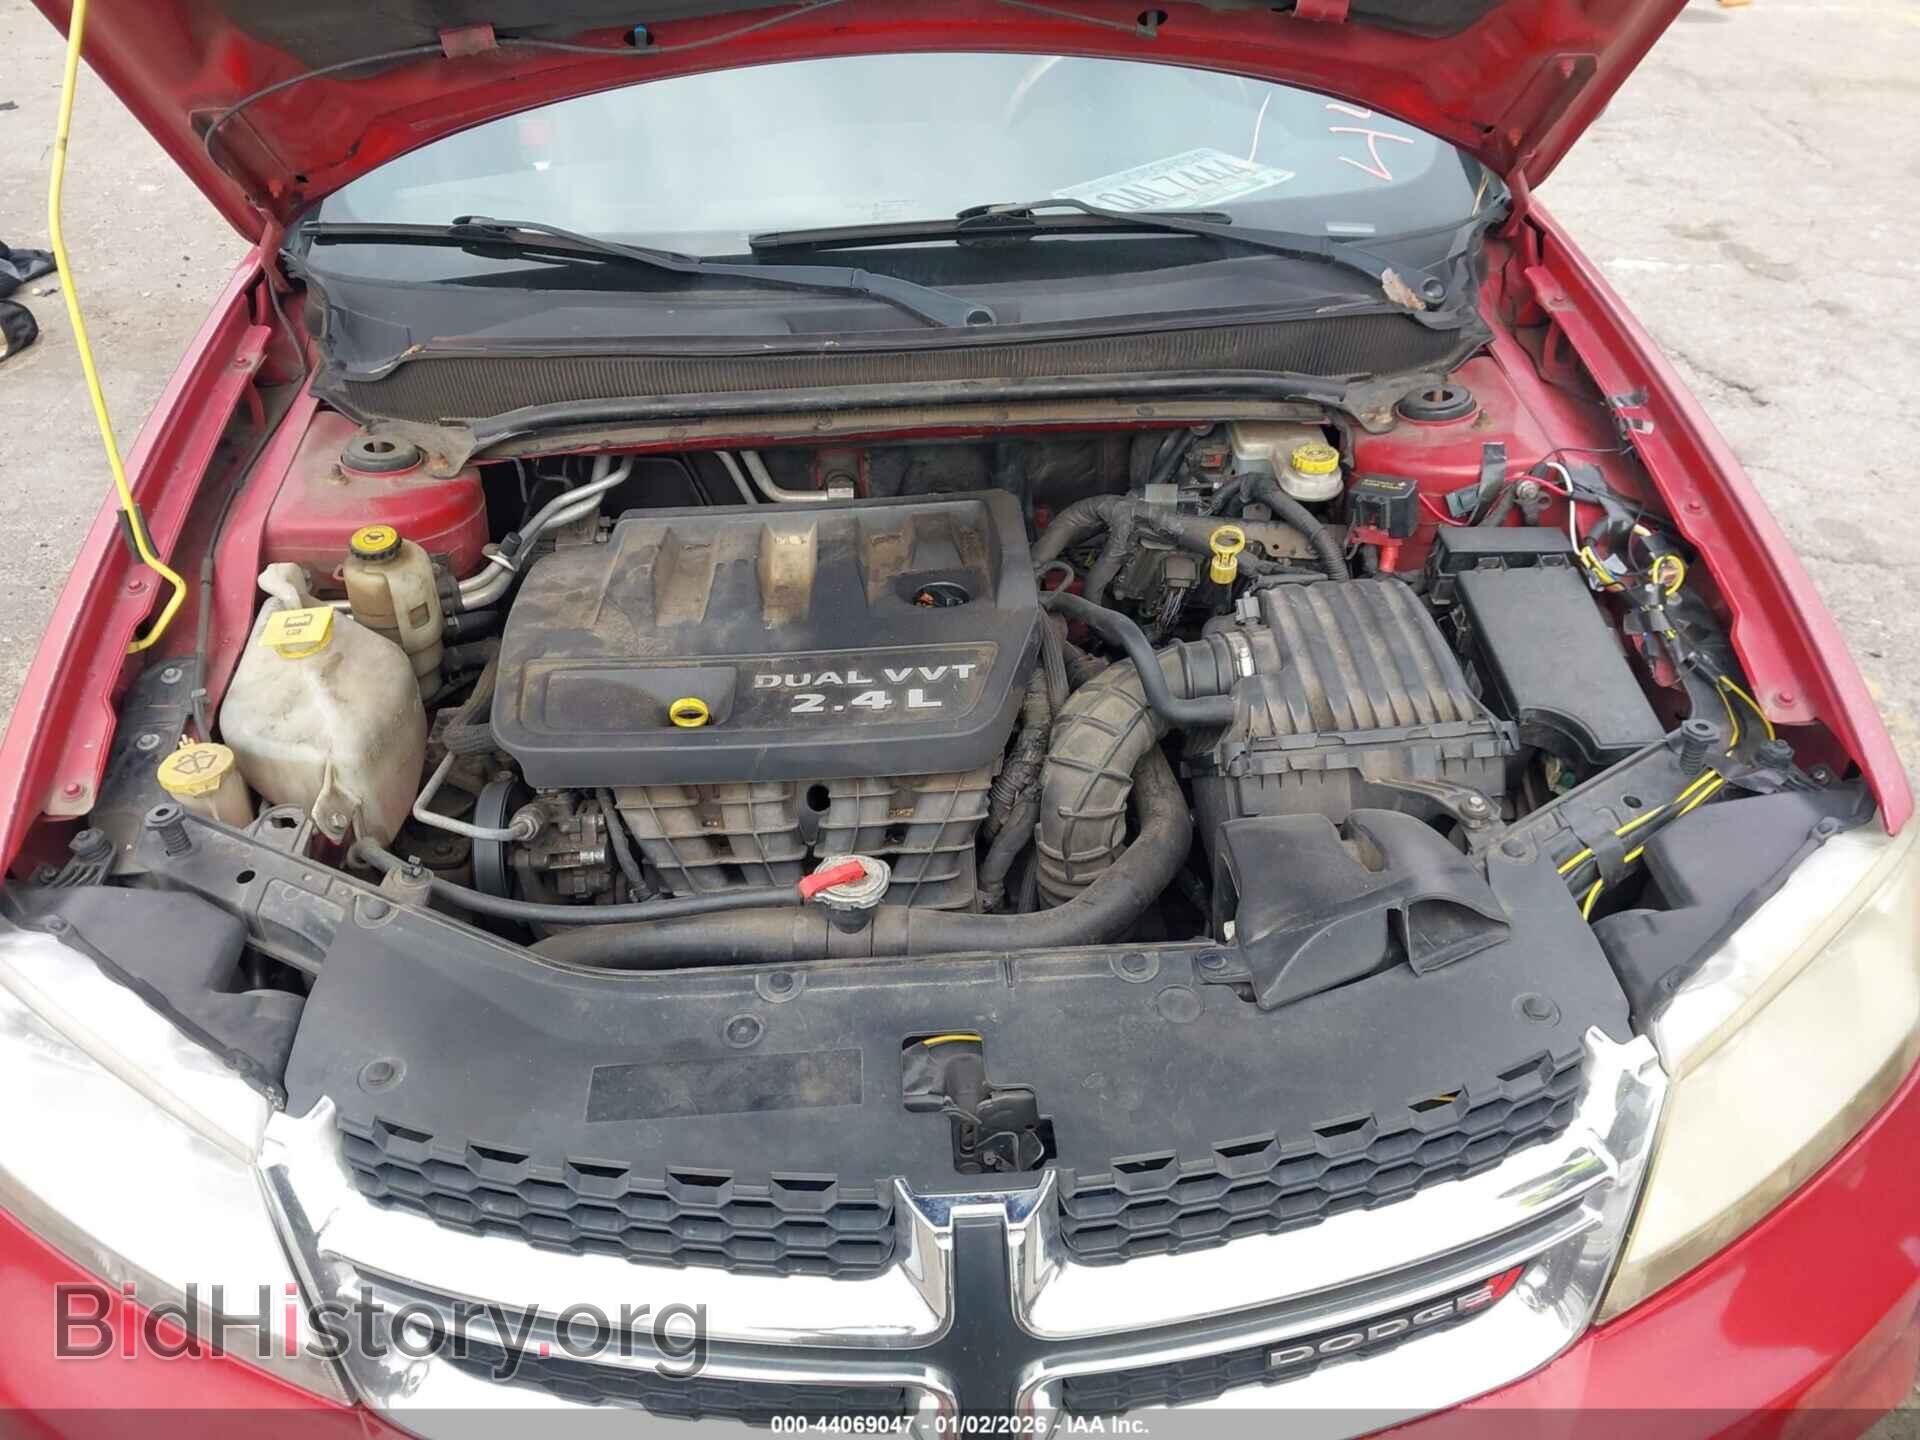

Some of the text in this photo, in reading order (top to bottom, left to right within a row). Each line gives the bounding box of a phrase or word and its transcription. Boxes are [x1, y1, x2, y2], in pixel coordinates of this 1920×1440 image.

[753, 663, 977, 689] DUAL VVT
[1269, 1284, 1494, 1369] DODGE
